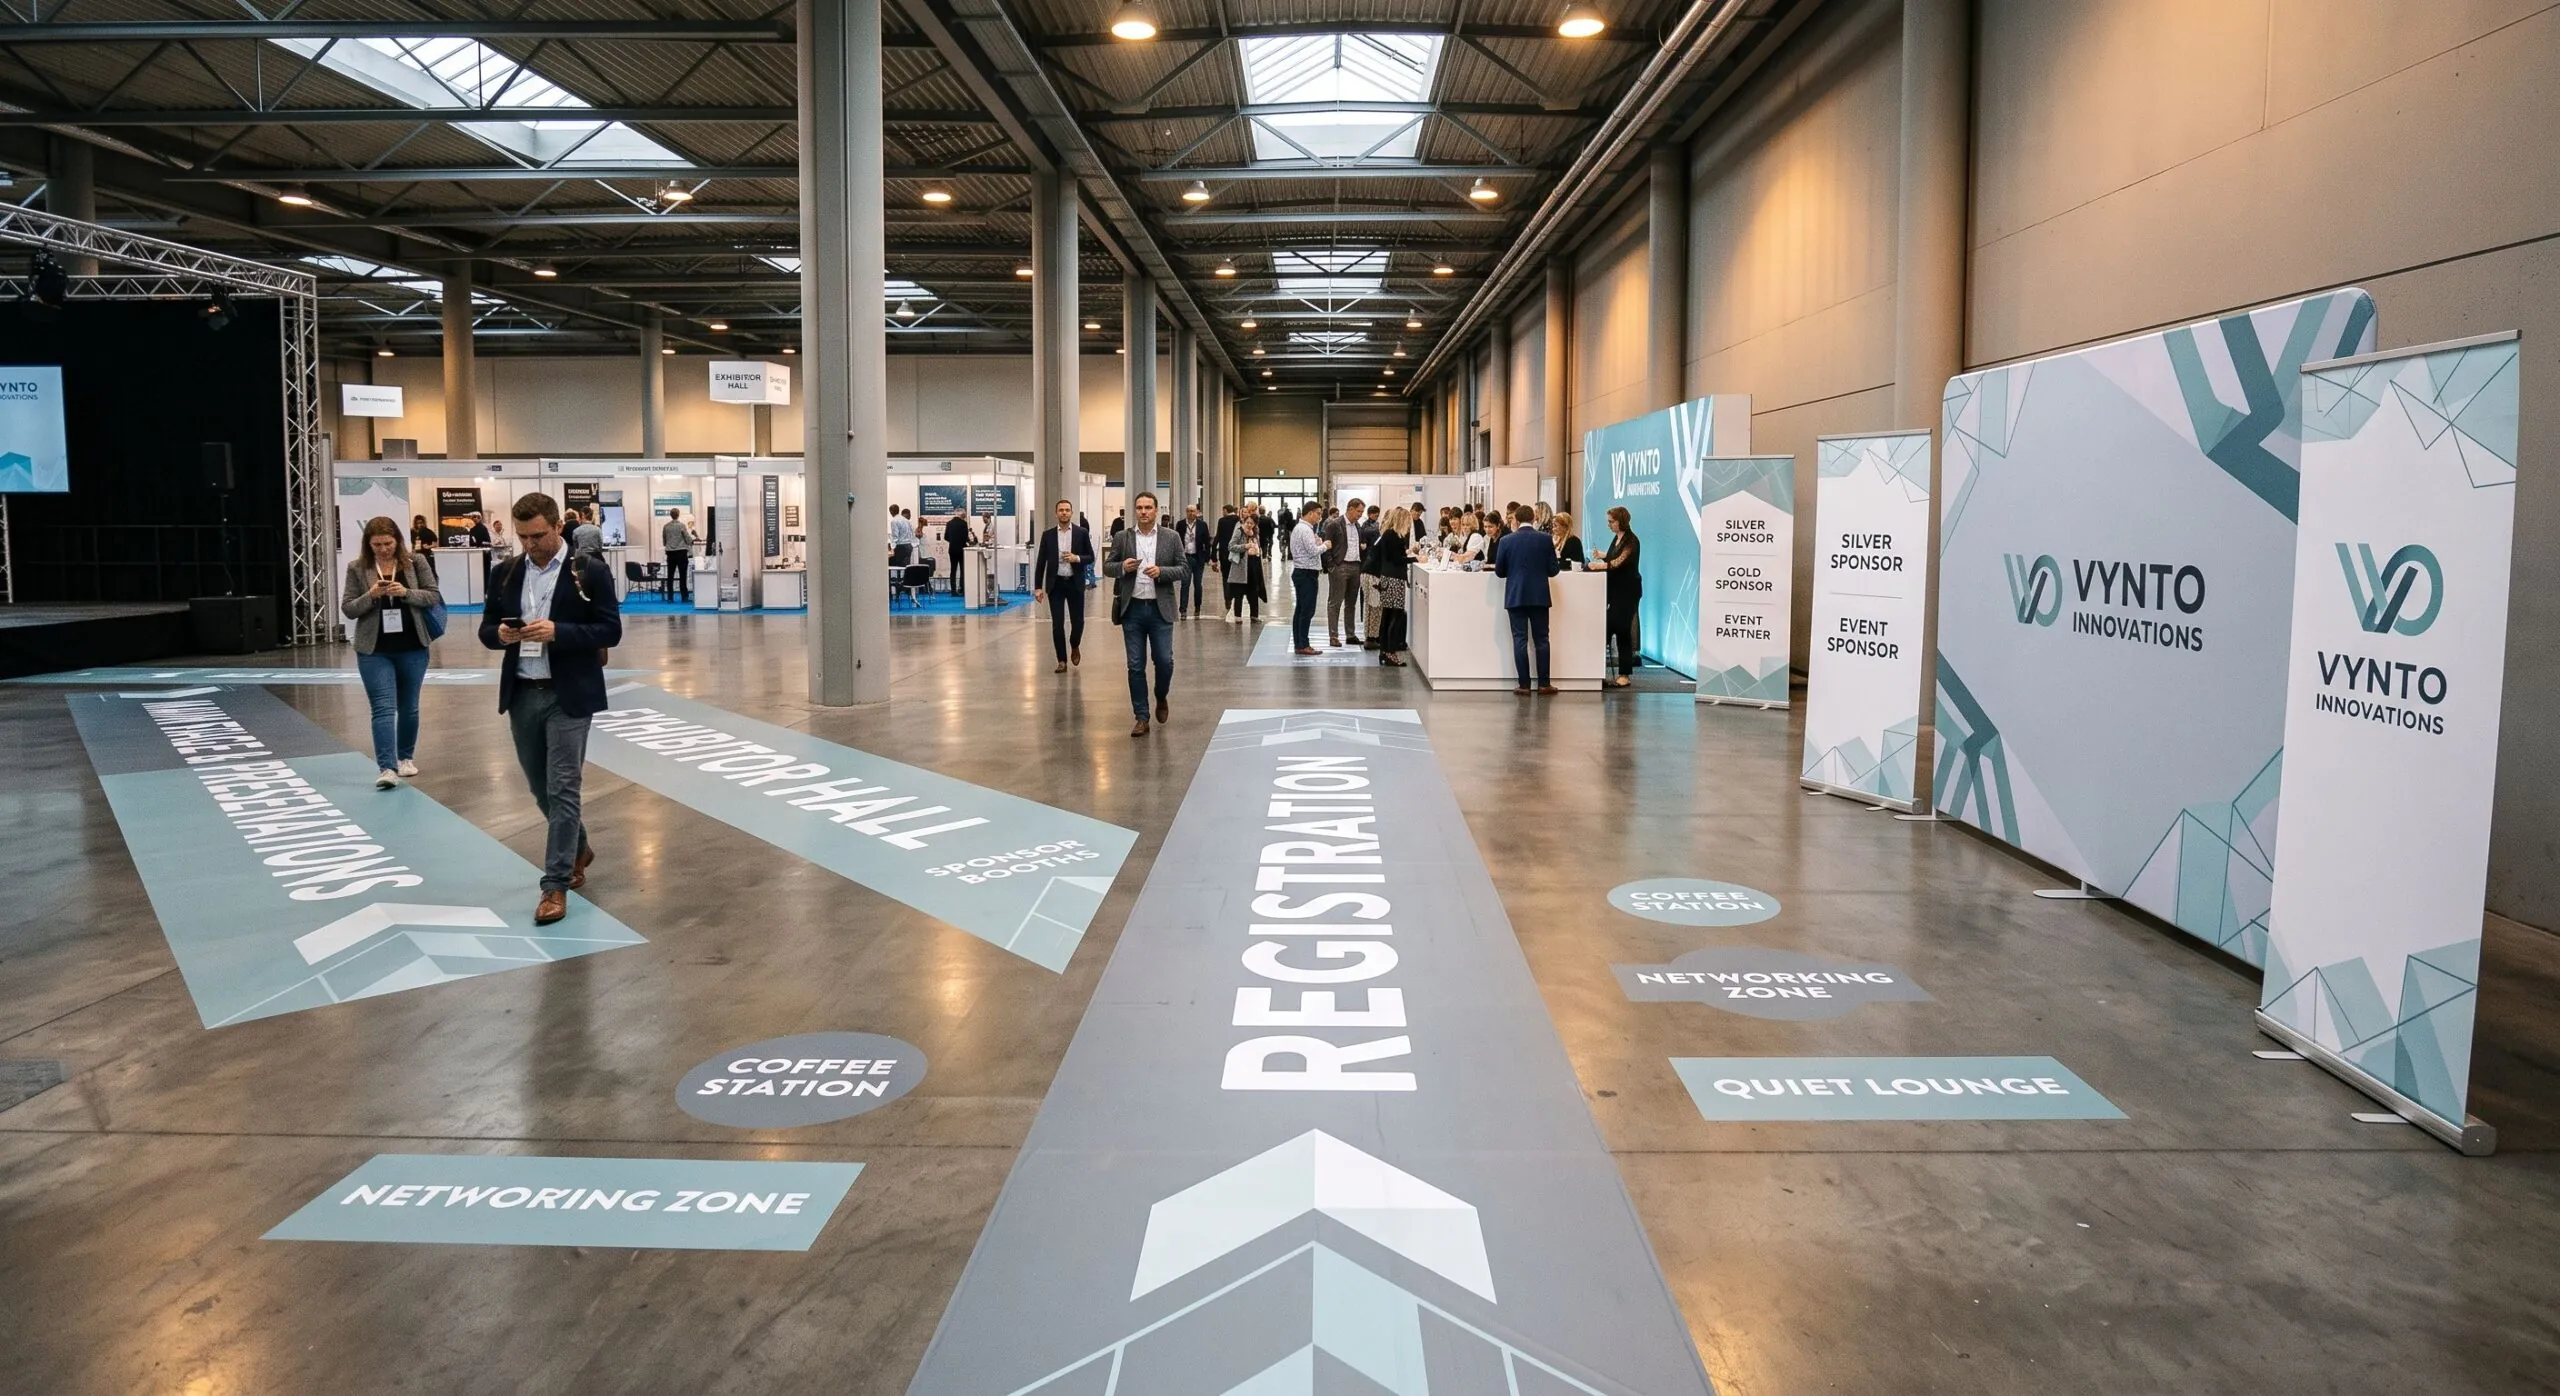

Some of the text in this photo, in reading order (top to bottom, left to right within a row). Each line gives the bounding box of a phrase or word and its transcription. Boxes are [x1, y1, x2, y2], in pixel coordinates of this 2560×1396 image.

[1627, 447, 1660, 477] VYNTO
[1725, 519, 1766, 530] SILVER
[1716, 532, 1774, 543] SPONSOR
[1841, 533, 1892, 549] SILVER
[1727, 567, 1761, 578] GOLD
[1830, 554, 1903, 572] SPONSOR
[1715, 580, 1773, 591] SPONSOR
[2073, 559, 2206, 614] VYNTO
[1724, 614, 1763, 625] EVENT
[1840, 617, 1888, 636] EVENT
[1716, 627, 1771, 640] PARTNER
[2072, 611, 2204, 652] INNOVATIONS
[1827, 637, 1899, 659] SPONSOR
[2317, 651, 2447, 705] VYNTO
[2315, 693, 2444, 735] INNOVATIONS
[763, 777, 991, 851] HALL
[924, 839, 1086, 877] SPONSOR
[957, 850, 1100, 885] BOOTHS
[1629, 891, 1749, 900] COFFEE
[1631, 901, 1765, 911] STATION
[1220, 756, 1417, 1091] REGISTRATION
[1636, 972, 1894, 985] NETWORKING
[1721, 986, 1832, 999] ZONE
[727, 1058, 897, 1075] COFFEE
[696, 1078, 891, 1098] STATION
[1713, 1077, 2070, 1099] QUIET LOUNGE
[662, 1190, 813, 1215] ZONE
